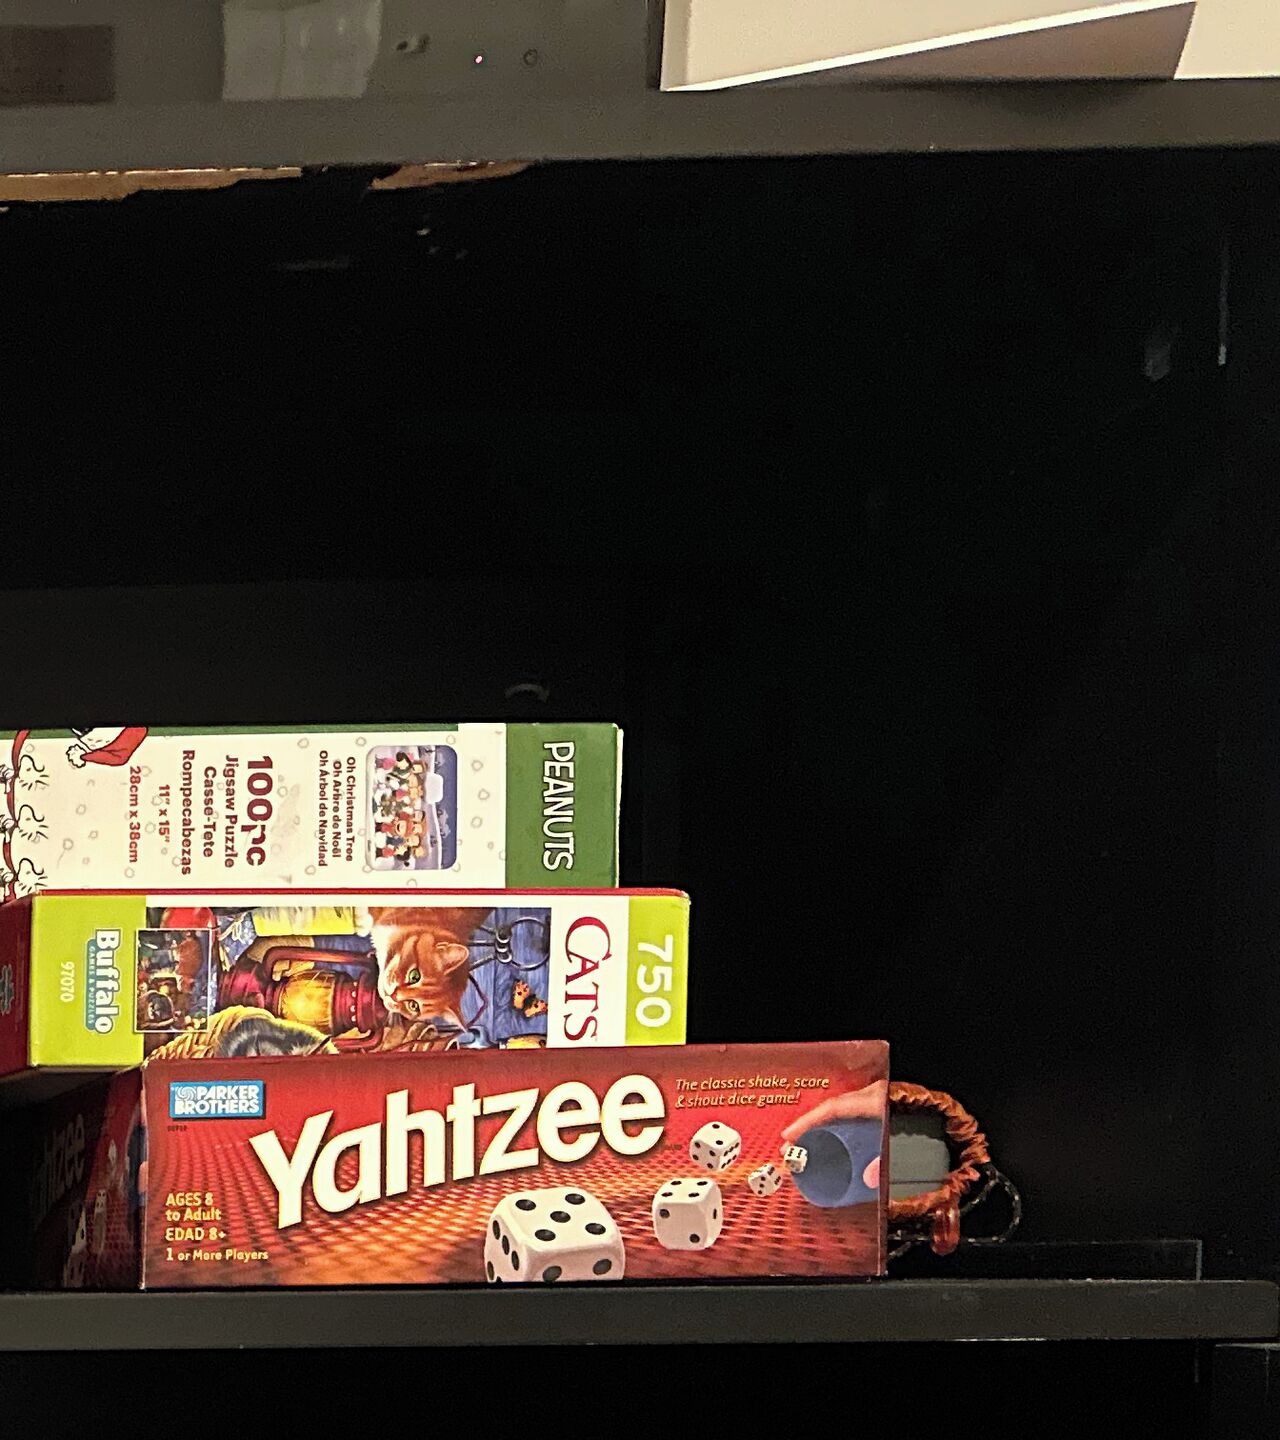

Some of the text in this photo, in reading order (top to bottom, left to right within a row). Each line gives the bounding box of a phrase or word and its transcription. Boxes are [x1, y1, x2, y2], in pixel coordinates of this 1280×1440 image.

[224, 754, 239, 869] Jigsaw Puzzle
[542, 741, 575, 872] PEANUTS
[59, 962, 75, 1002] 97070
[95, 929, 122, 1035] Buffalo
[565, 916, 612, 1042] CATS
[635, 934, 674, 1028] 750
[174, 1098, 260, 1115] BROTHERS
[196, 1085, 260, 1100] PARKER
[675, 1074, 830, 1091] The classic shake, score
[248, 1074, 666, 1230] Yahtzee
